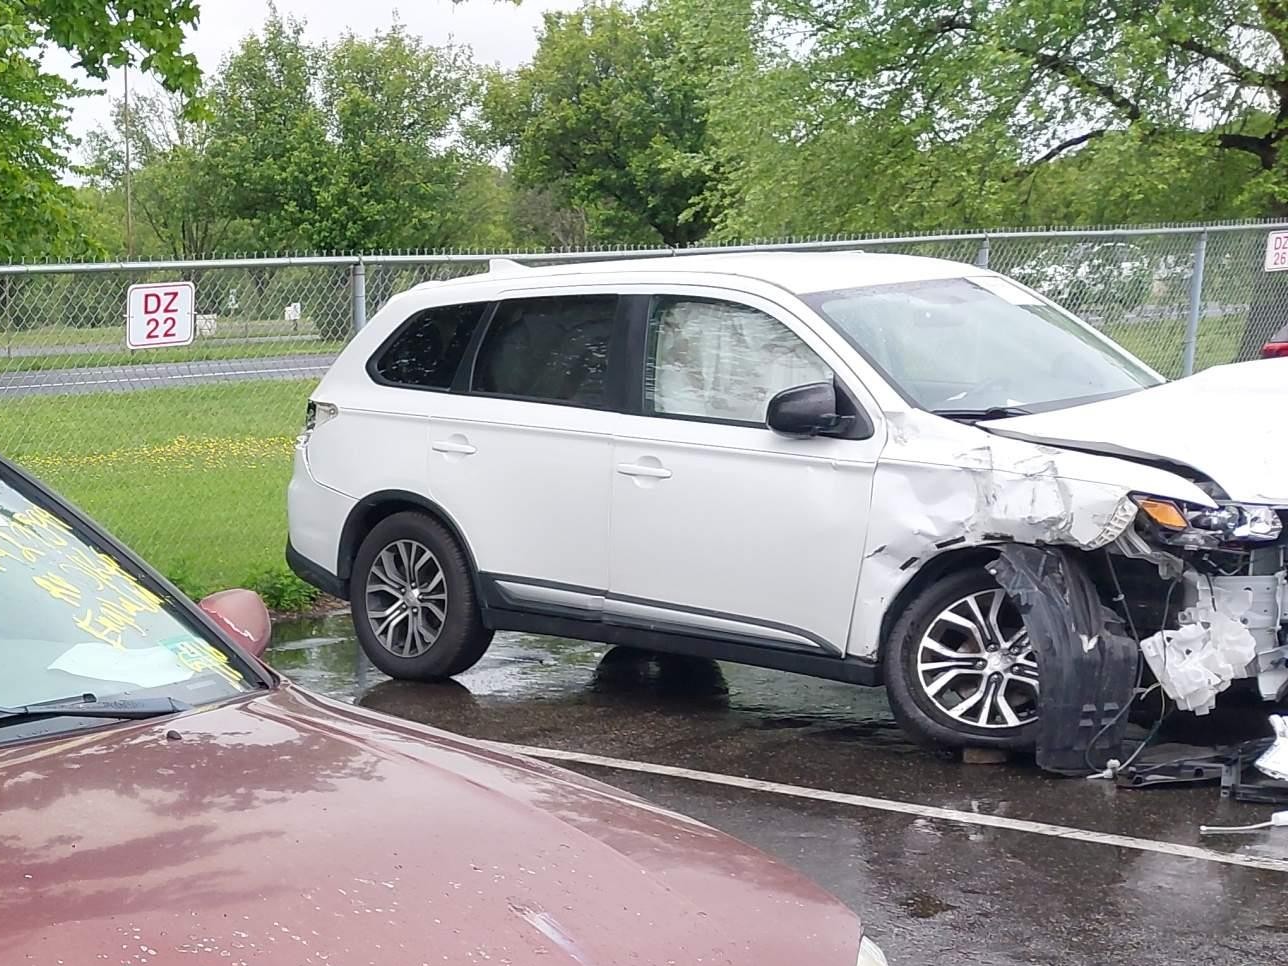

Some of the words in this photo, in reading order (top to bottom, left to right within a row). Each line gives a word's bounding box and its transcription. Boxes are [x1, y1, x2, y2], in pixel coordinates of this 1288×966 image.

[1273, 252, 1286, 266] 26
[144, 292, 179, 315] DZ
[145, 317, 177, 340] 22
